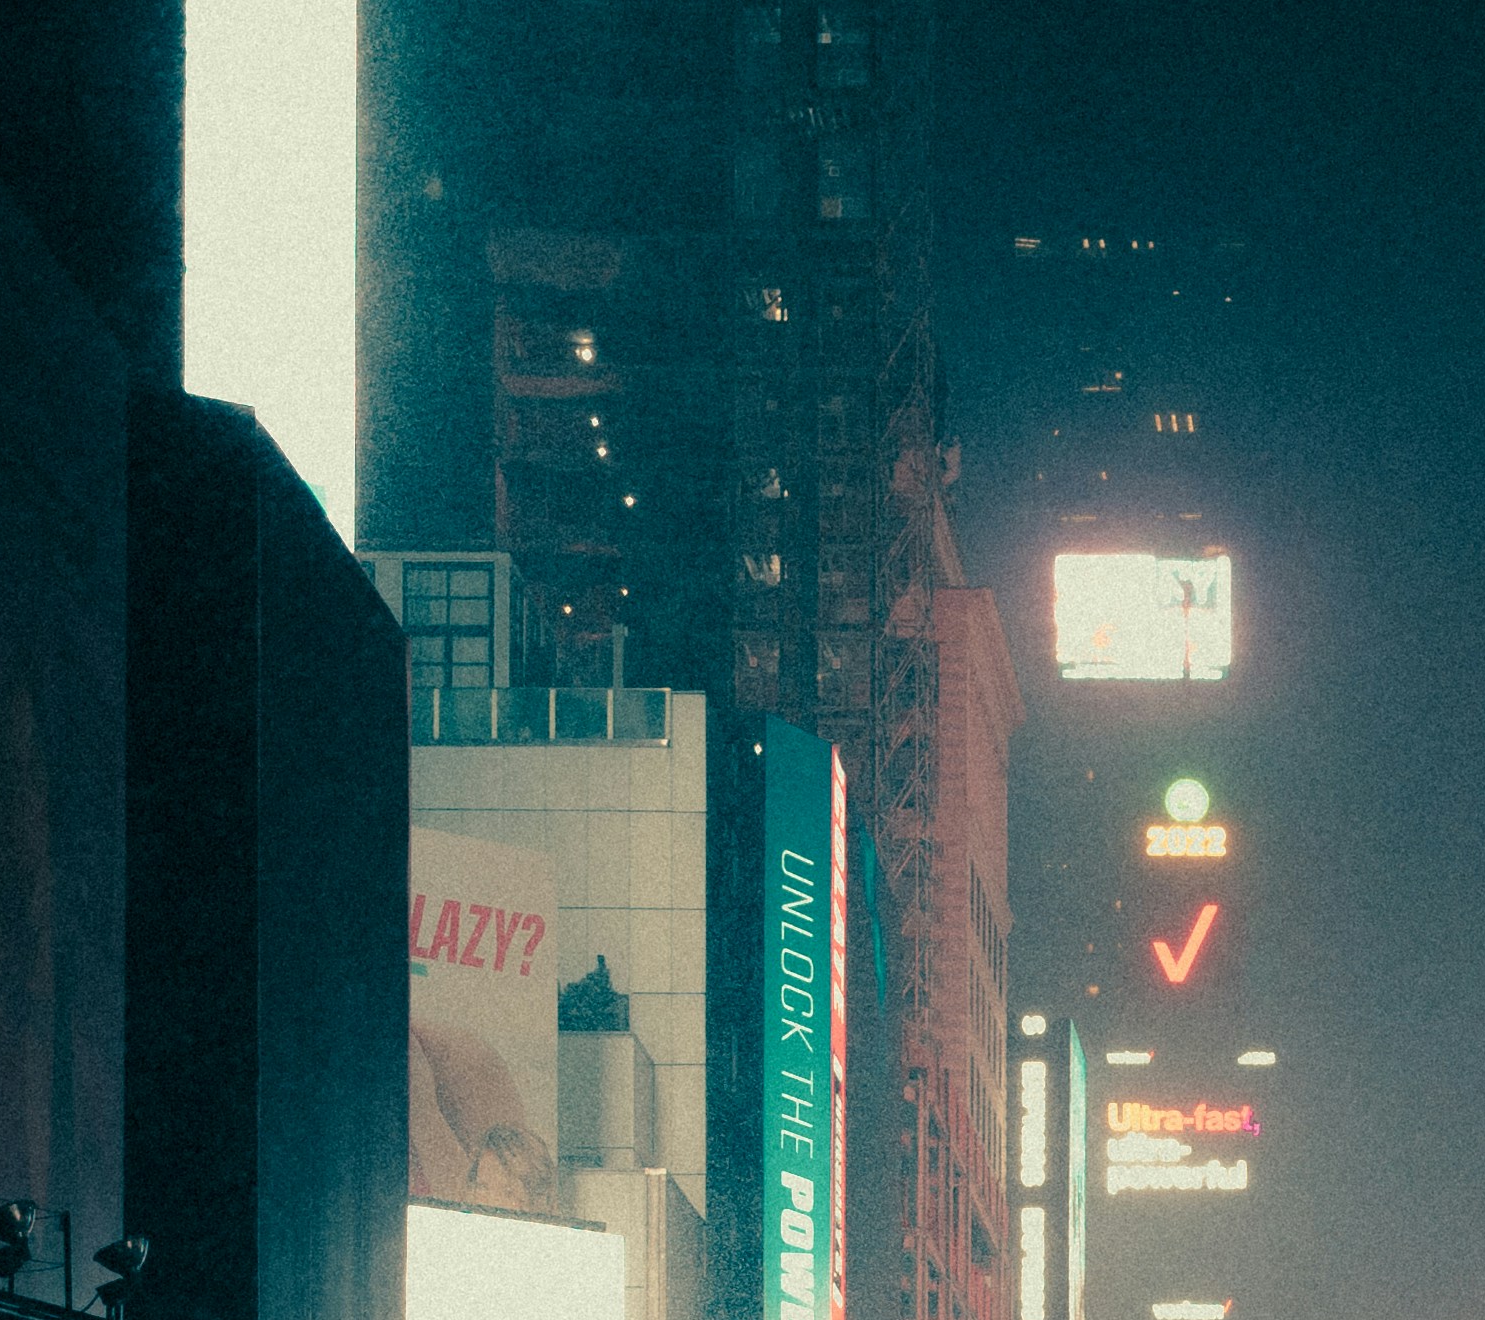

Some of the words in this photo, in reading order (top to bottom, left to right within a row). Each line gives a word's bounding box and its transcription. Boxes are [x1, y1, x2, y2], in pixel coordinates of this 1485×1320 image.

[1146, 826, 1227, 857] 2022
[832, 754, 845, 1023] COLATE
[410, 894, 546, 977] LAZY?
[781, 849, 815, 1054] UNLOCK
[780, 1069, 814, 1160] THE
[1107, 1103, 1262, 1136] Ultra-fast,
